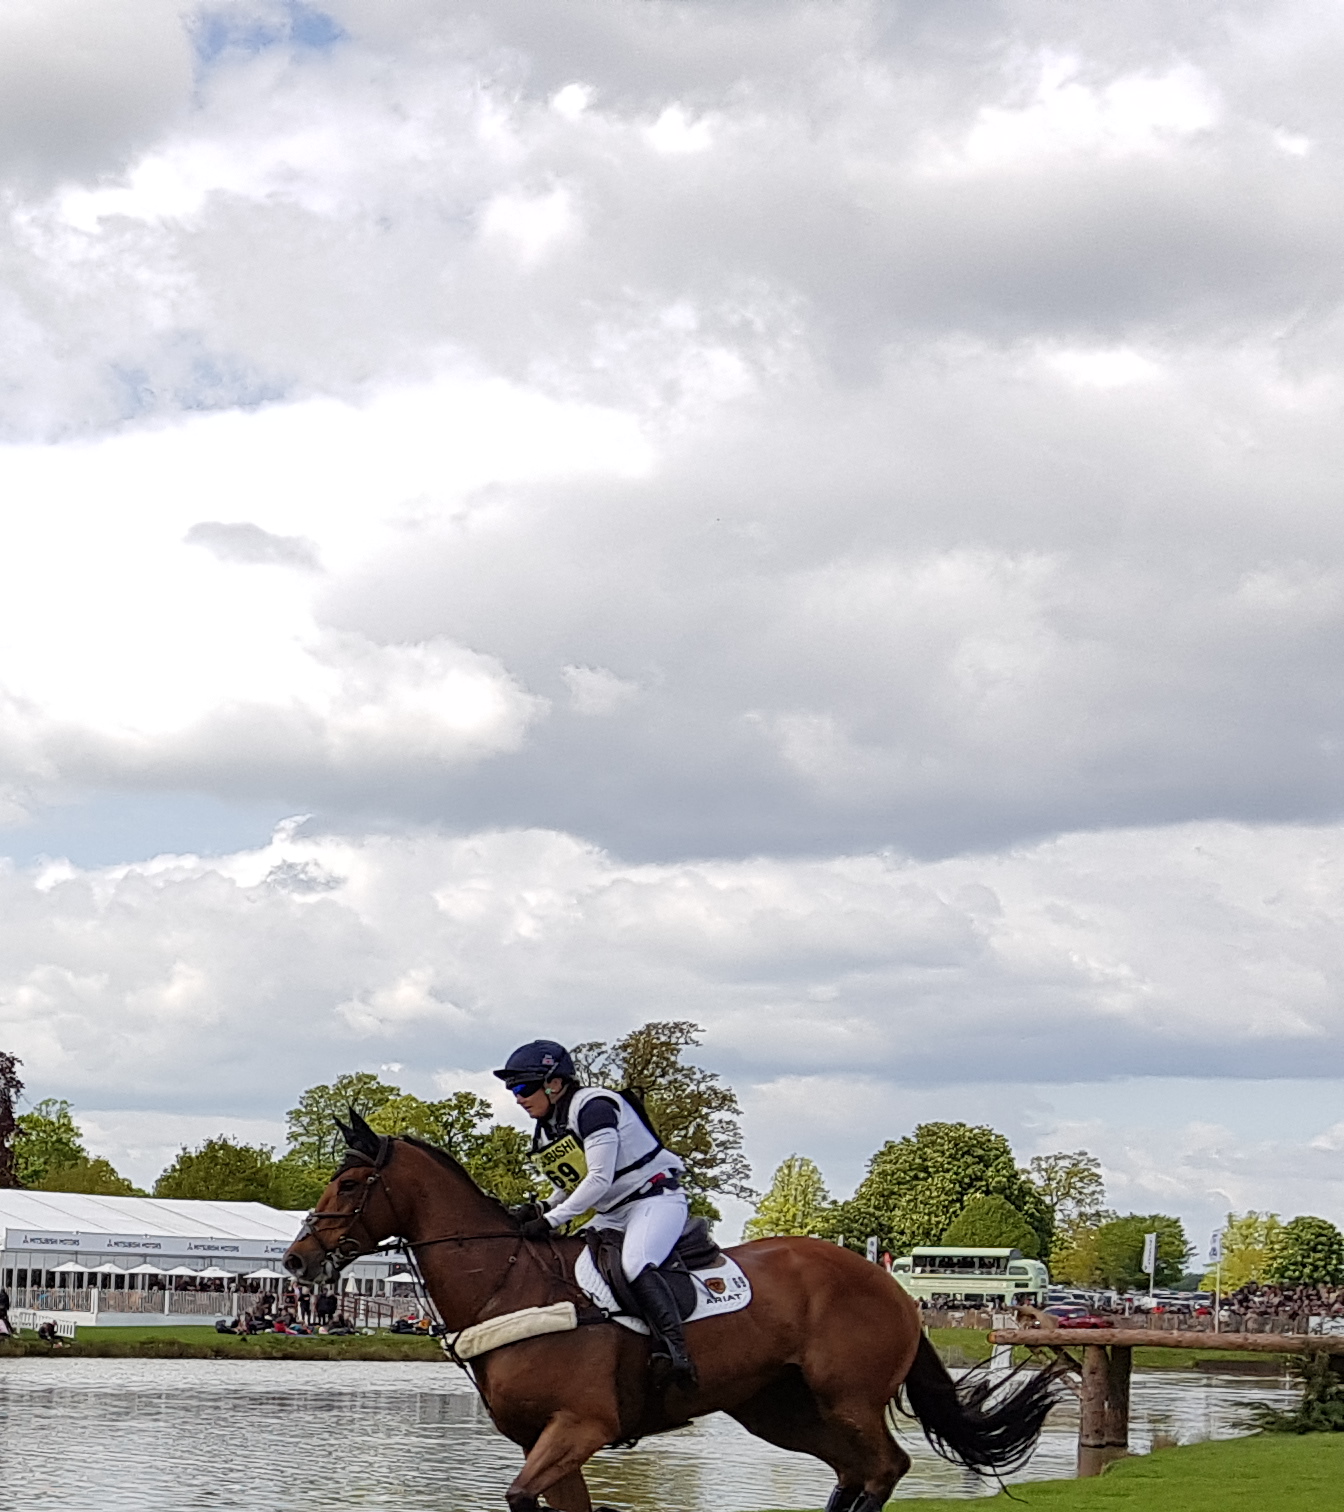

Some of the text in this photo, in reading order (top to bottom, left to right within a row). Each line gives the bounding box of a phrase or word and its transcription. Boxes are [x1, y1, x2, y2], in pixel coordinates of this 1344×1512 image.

[546, 1162, 580, 1190] 69
[732, 1276, 746, 1288] 69
[706, 1293, 743, 1304] ARIAT
